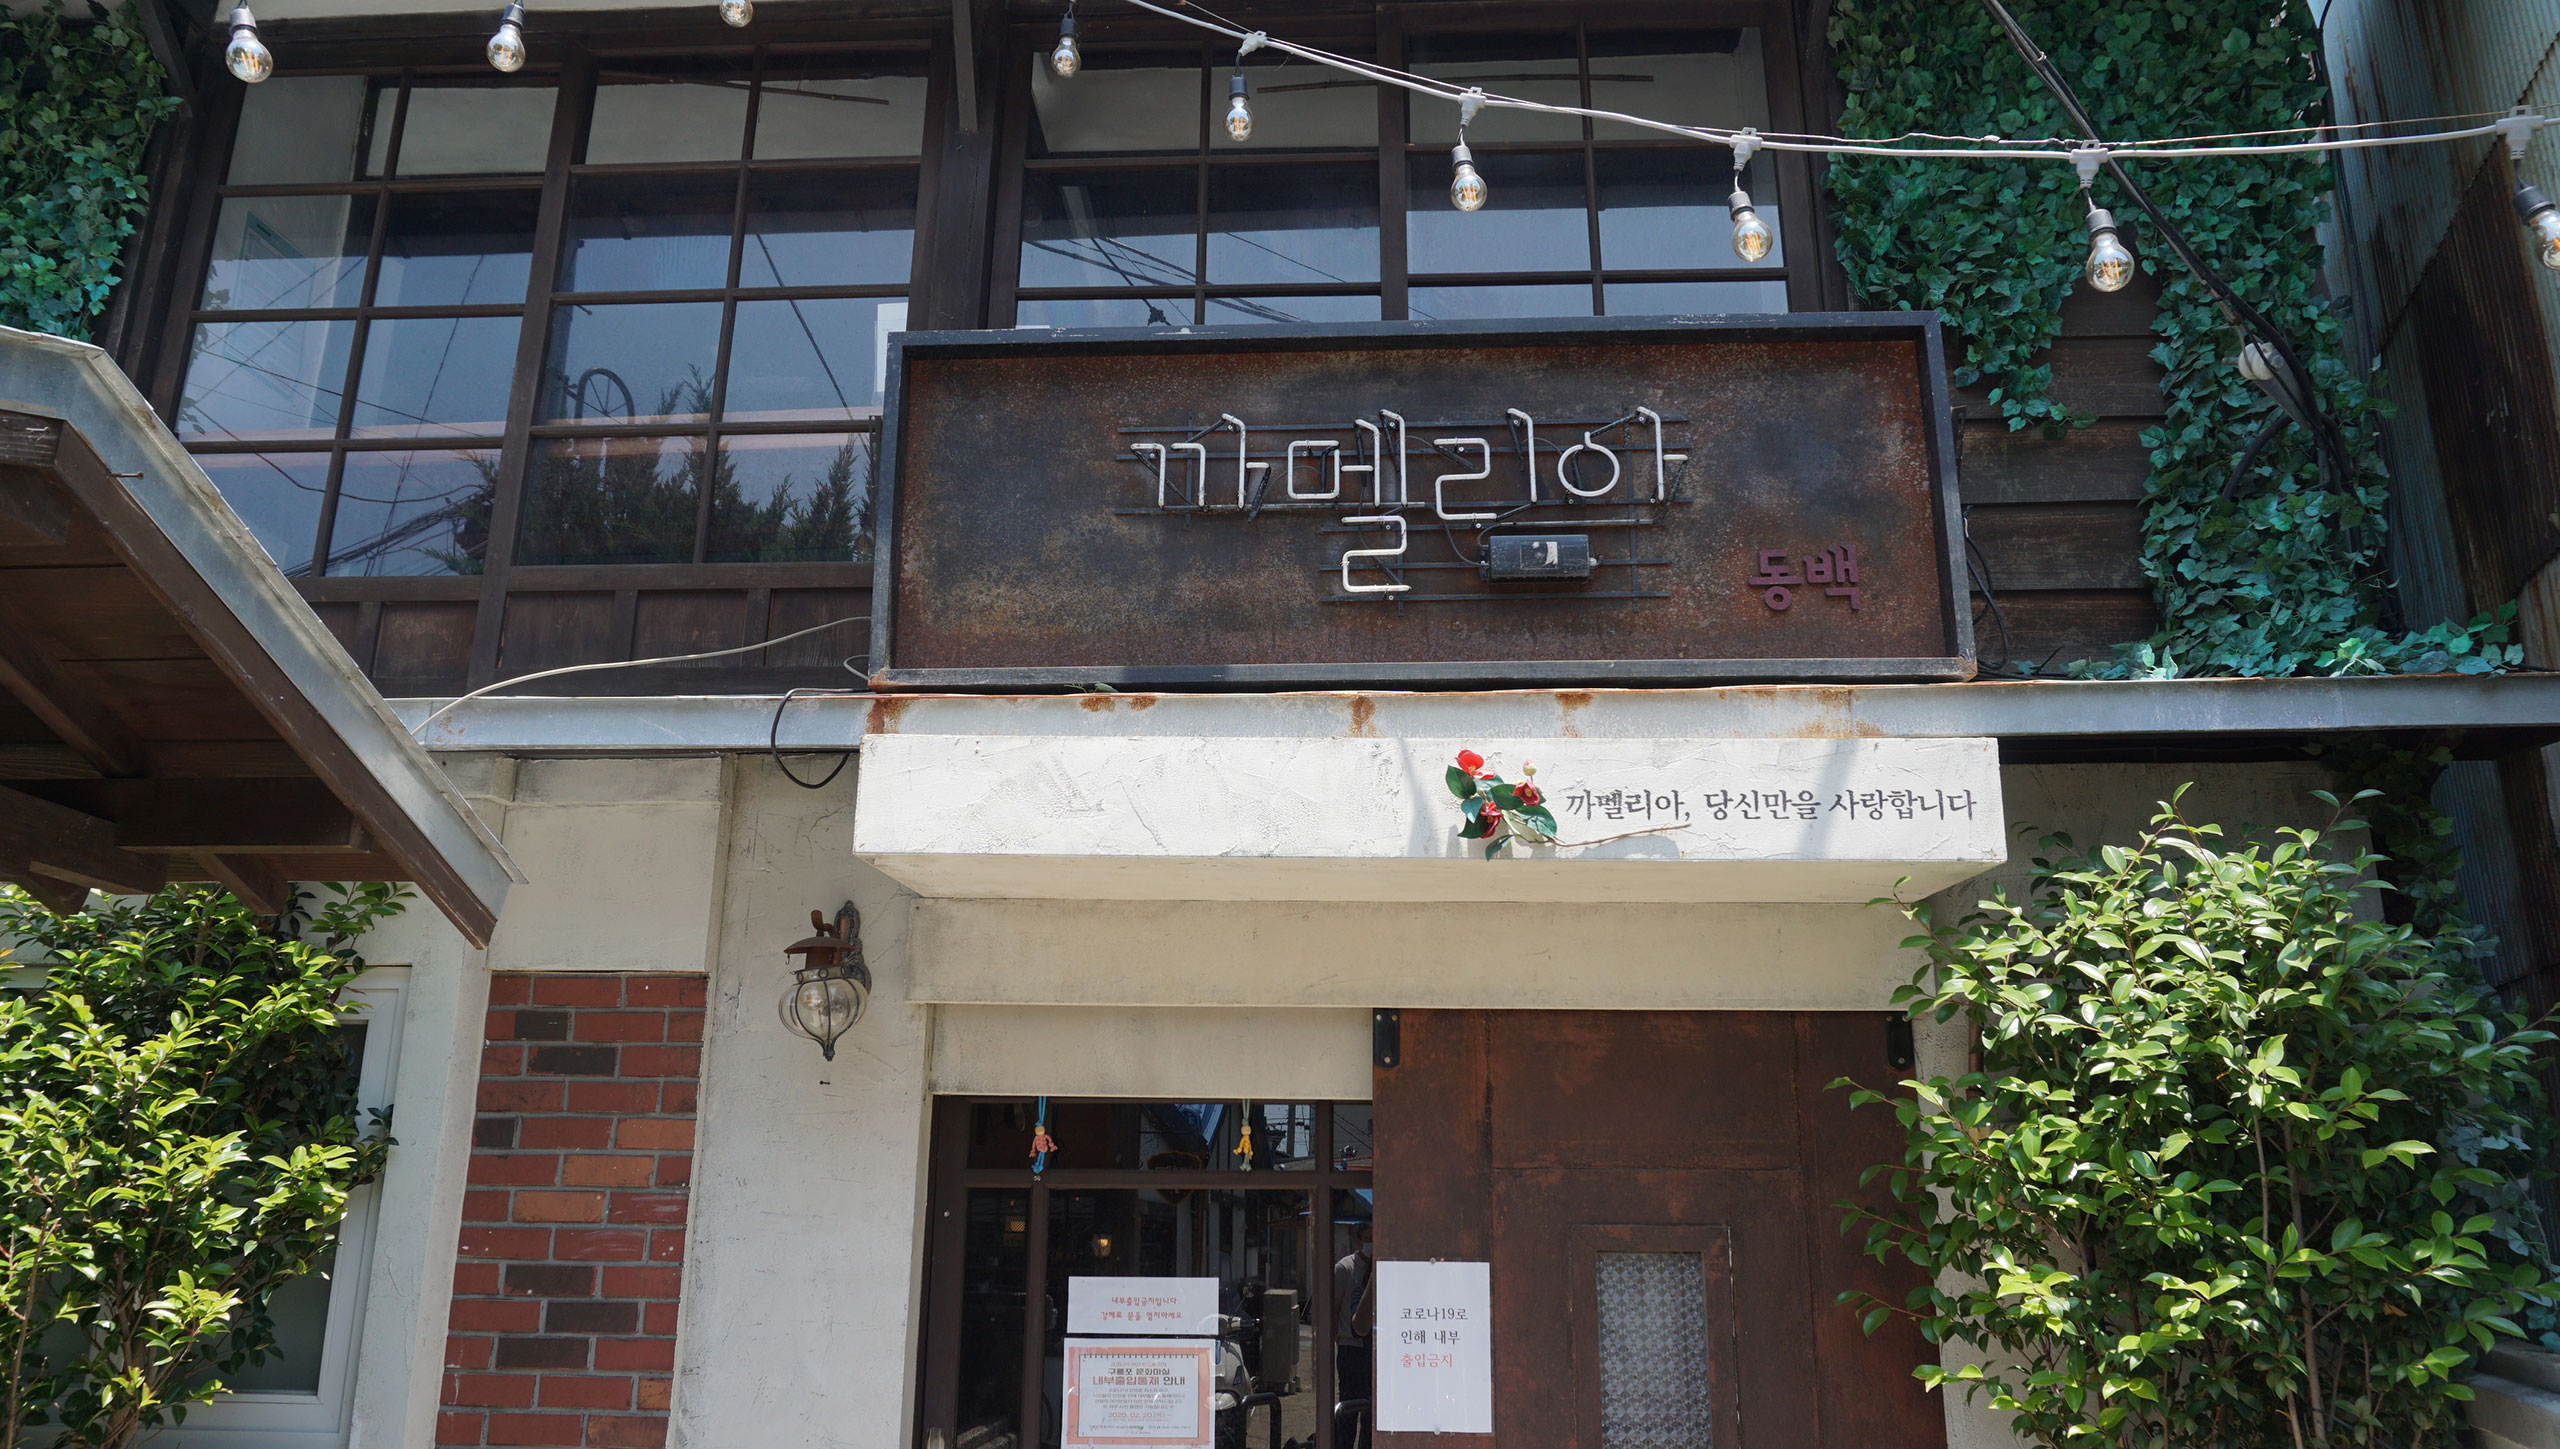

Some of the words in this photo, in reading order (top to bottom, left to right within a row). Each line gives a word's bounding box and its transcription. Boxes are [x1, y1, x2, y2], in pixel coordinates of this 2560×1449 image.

[1129, 405, 1689, 594] 까멜리아
[1748, 542, 1860, 611] 동백
[1565, 788, 1691, 822] 까멜리아,
[1704, 788, 1820, 821] 당신만을
[1828, 788, 1977, 821] 사랑합니다
[1111, 1297, 1177, 1307] 내부출입금지입니다
[1399, 1307, 1468, 1321] 코로나19로
[1400, 1329, 1426, 1345] 인해
[1434, 1329, 1460, 1345] 내부
[1400, 1353, 1453, 1368] 출입금지
[1163, 1376, 1186, 1386] 안내
